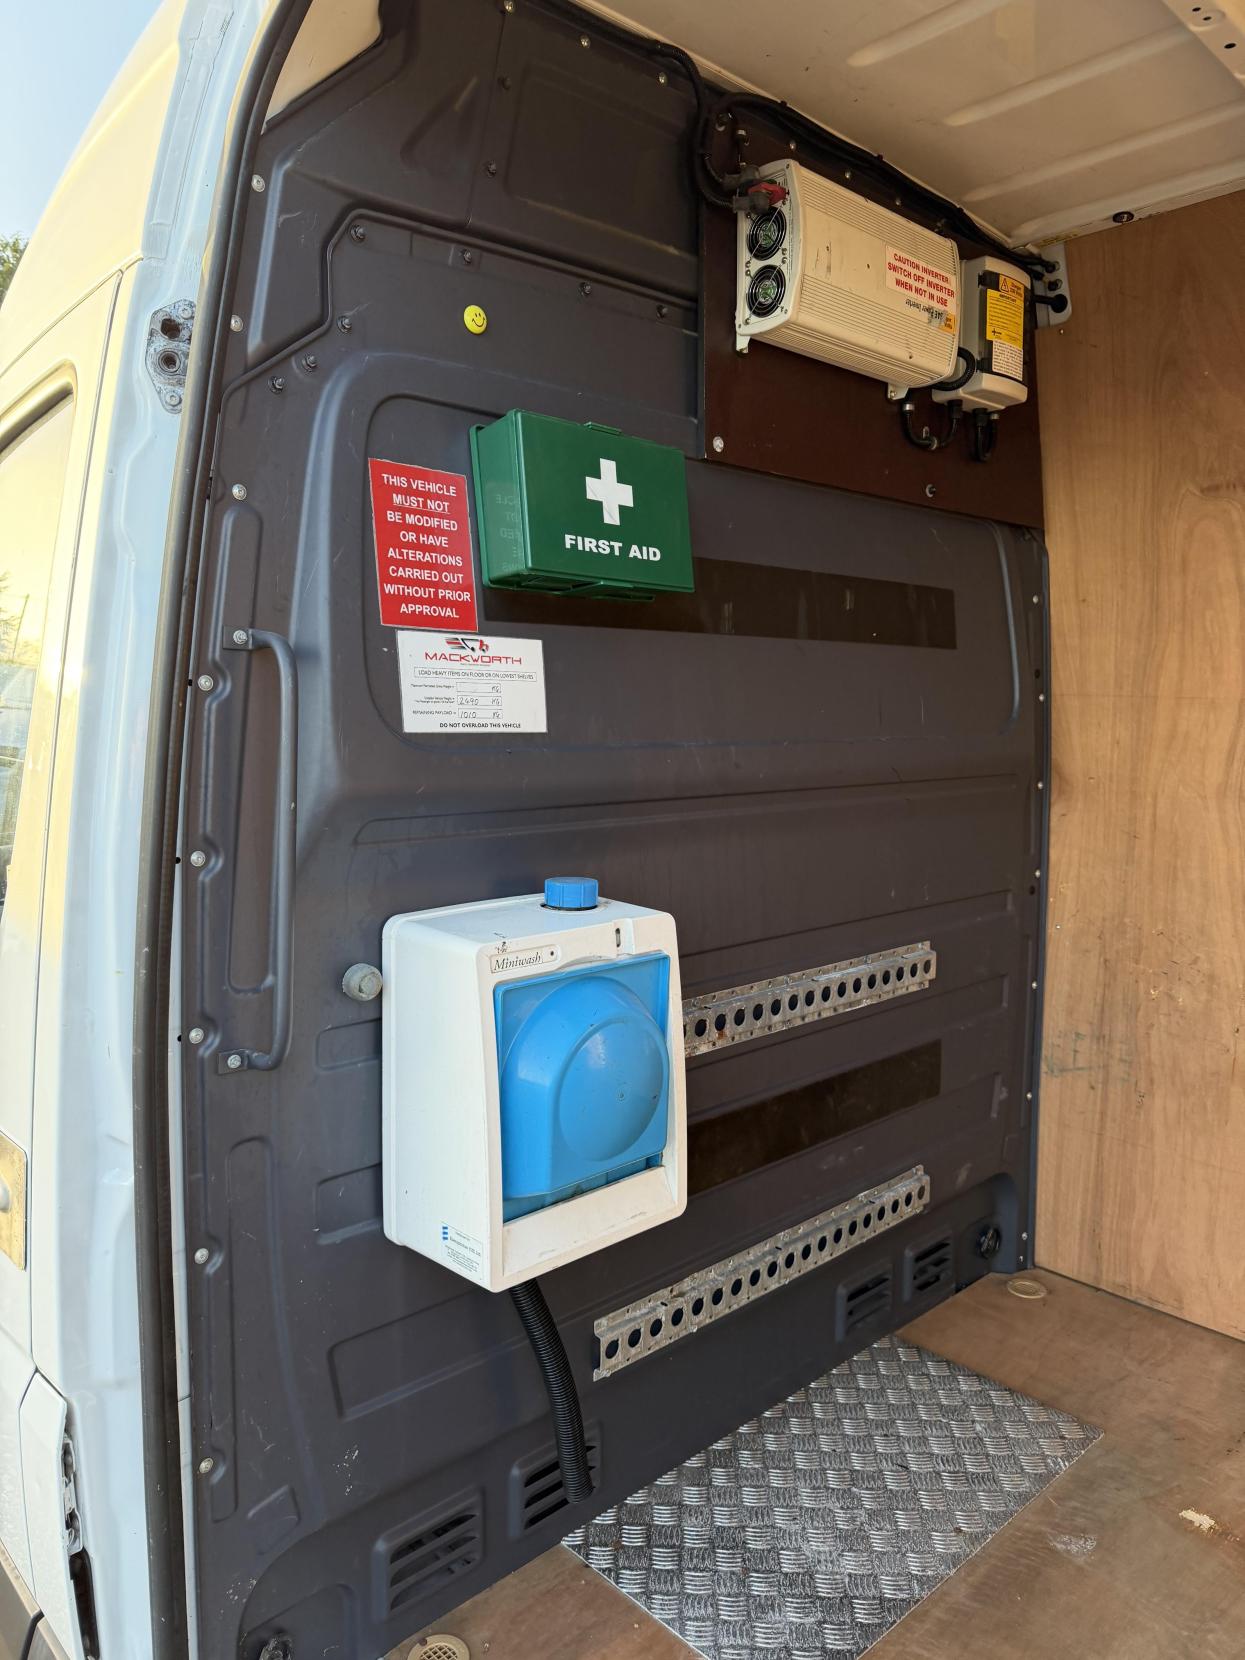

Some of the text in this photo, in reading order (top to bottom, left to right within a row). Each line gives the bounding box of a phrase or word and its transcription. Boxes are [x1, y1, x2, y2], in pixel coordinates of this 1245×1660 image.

[894, 253, 949, 284] CAUTION INVERTER
[888, 262, 954, 298] SWITCH OFF INVERTER
[895, 278, 948, 307] WHEN NOT IN USE
[382, 474, 457, 497] THIS VEHICLE
[393, 493, 450, 512] MUST NOT
[386, 511, 458, 531] BE MODIFIED
[400, 531, 448, 547] OR HAVE
[564, 534, 661, 562] FIRST AID
[388, 547, 462, 566] ALTERATIONS
[389, 566, 463, 584] CARRIED OUT
[384, 583, 471, 602] WITHOUT PRIOR
[400, 603, 459, 618] APPROVAL
[424, 652, 522, 665] MACKWORTH
[494, 952, 541, 970] Miniwash
